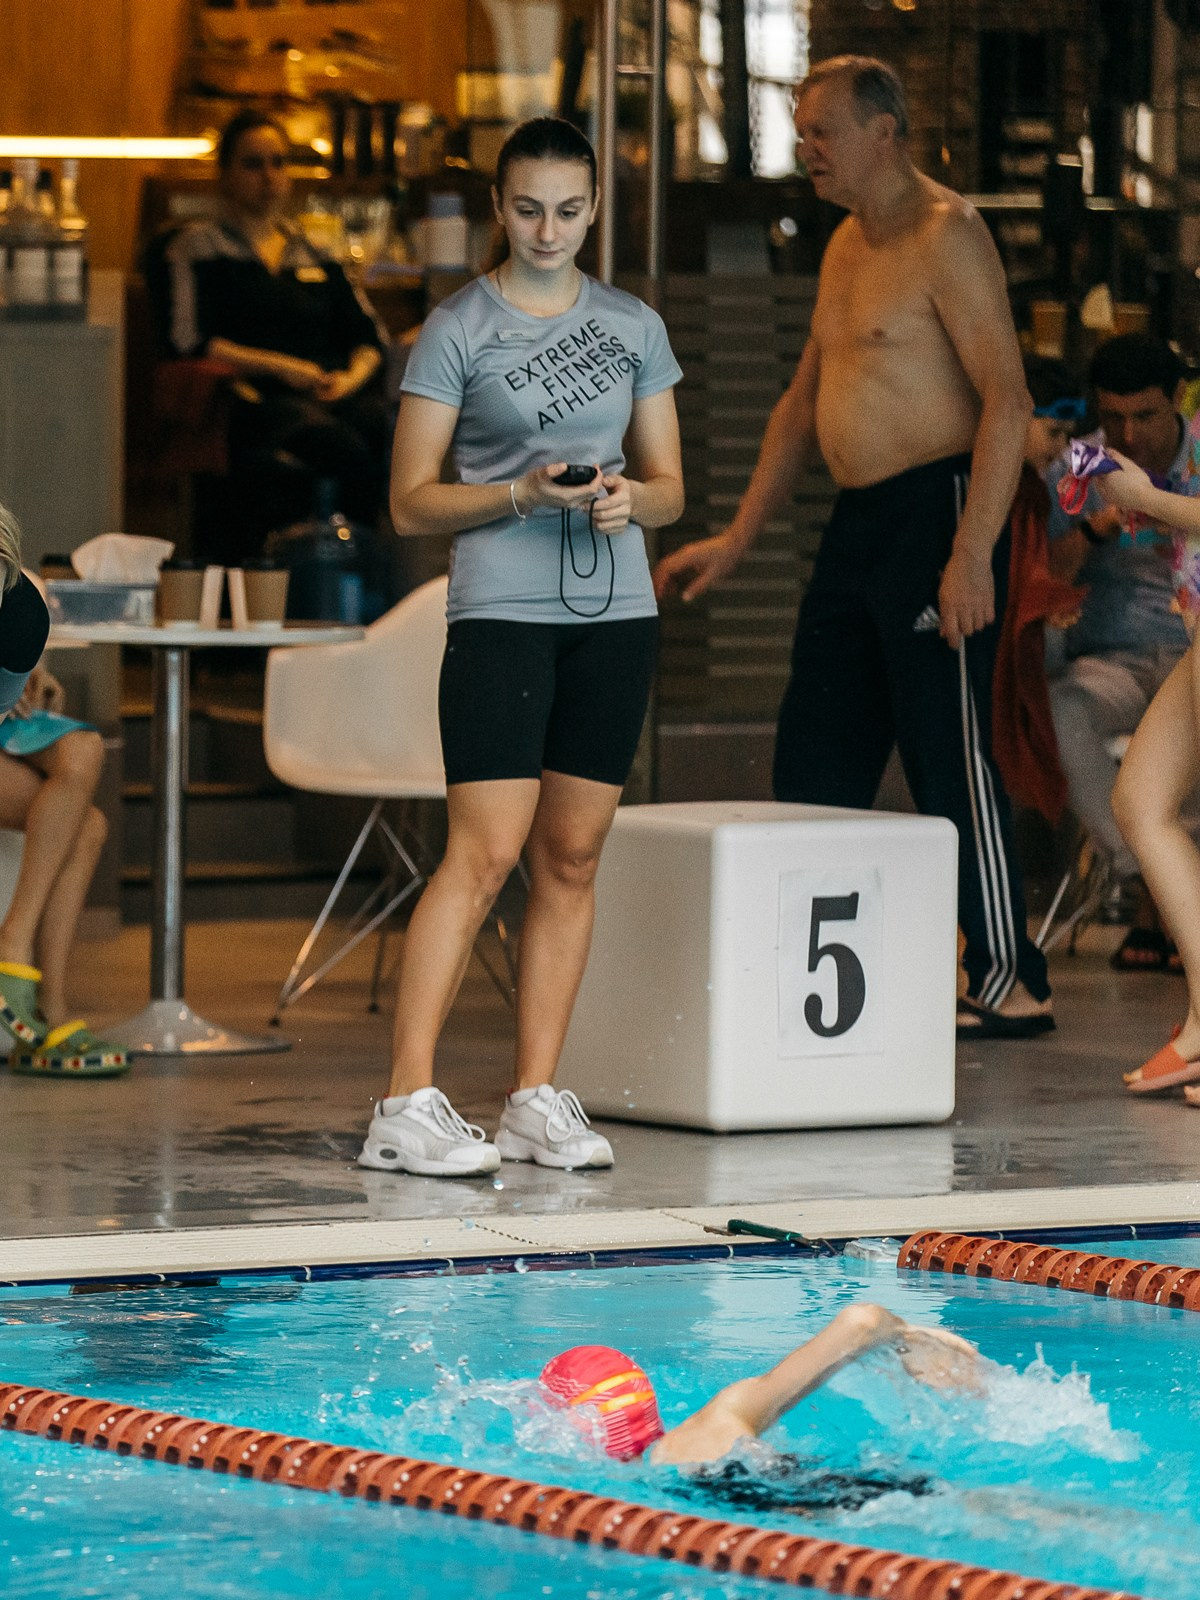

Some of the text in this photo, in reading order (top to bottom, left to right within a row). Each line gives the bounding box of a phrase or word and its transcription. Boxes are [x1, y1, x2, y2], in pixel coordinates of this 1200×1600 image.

[504, 318, 606, 392] EXTREME
[537, 351, 643, 431] ATHLETICS
[541, 335, 626, 398] FITNESS
[804, 891, 866, 1038] 5
